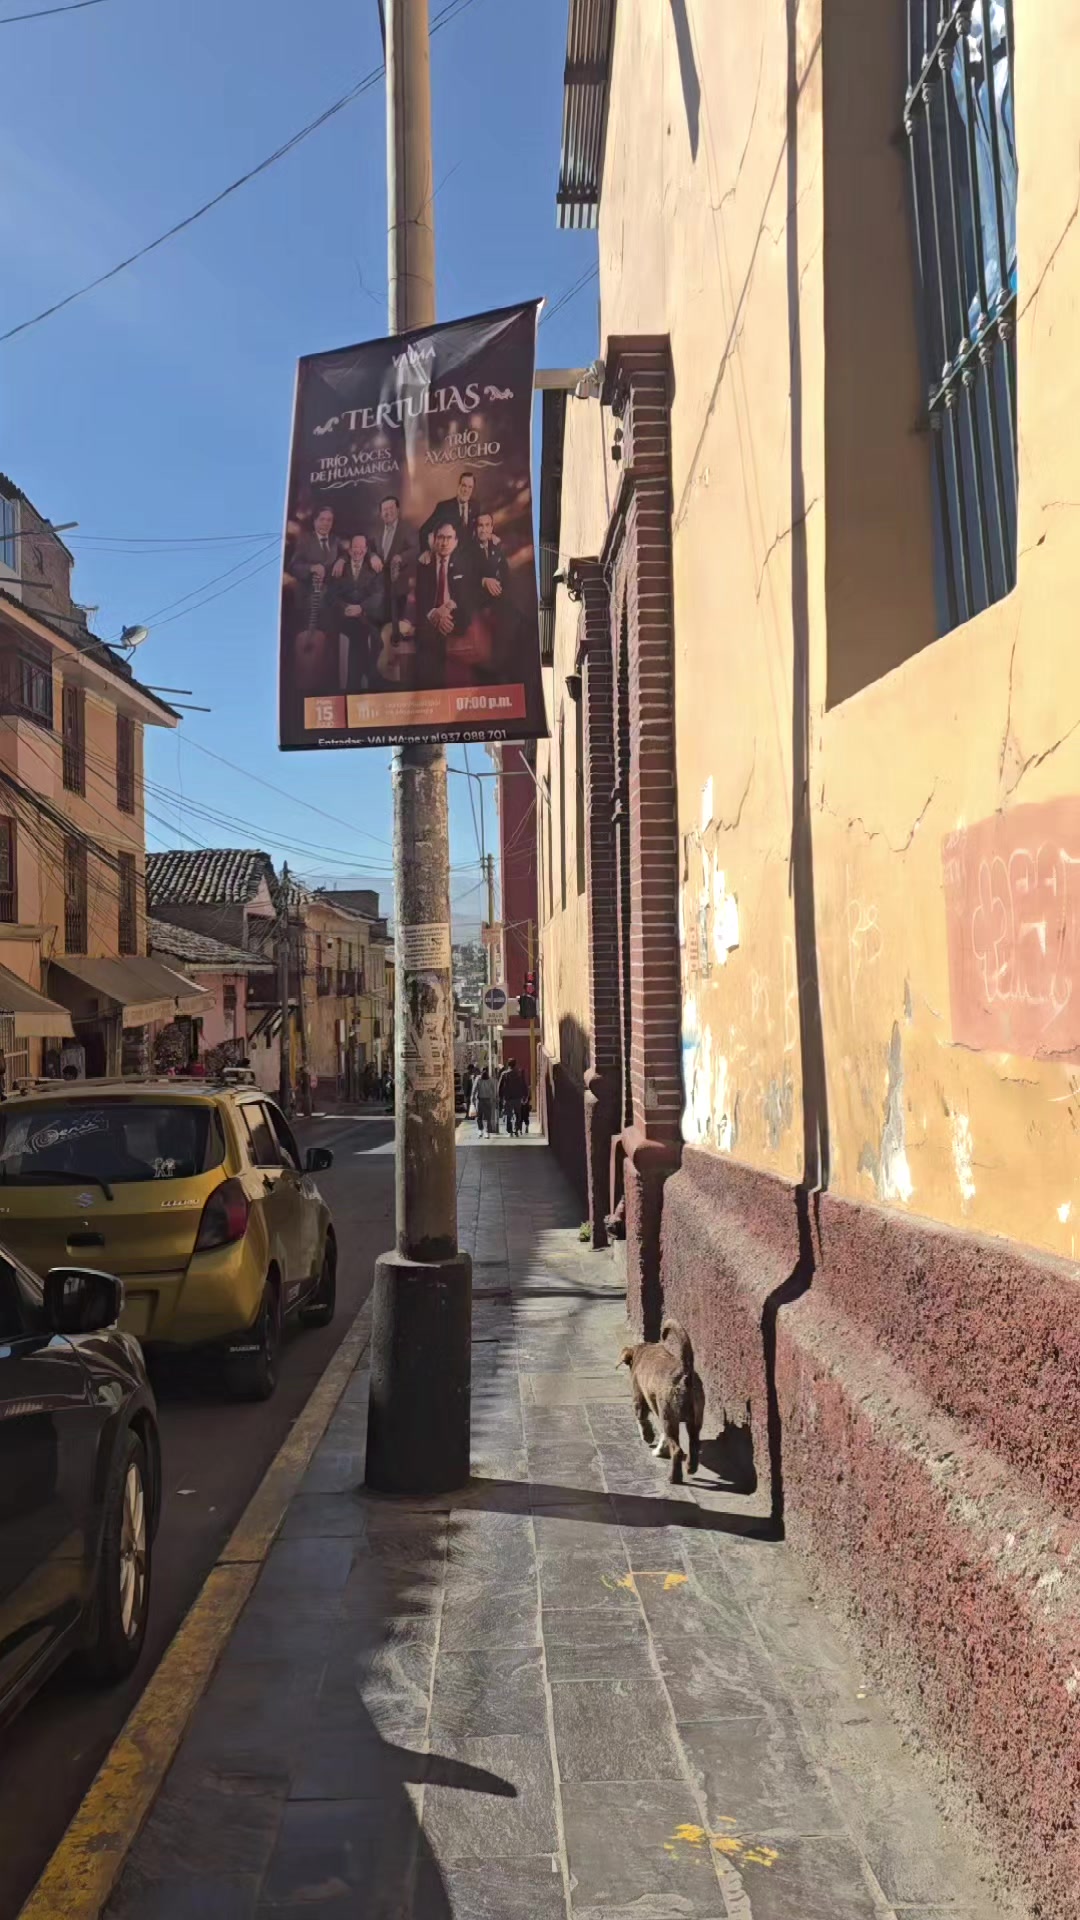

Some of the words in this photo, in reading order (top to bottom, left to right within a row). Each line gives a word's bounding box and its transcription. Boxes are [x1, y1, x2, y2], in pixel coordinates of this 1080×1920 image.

[341, 382, 480, 430] TERTULIAS
[444, 429, 479, 446] TRÍO
[319, 454, 348, 471] TRÍO
[351, 448, 392, 463] VOCES
[424, 441, 501, 465] AYACUCHO
[310, 470, 327, 483] DE
[326, 460, 400, 482] HUAMANGA
[456, 695, 486, 711] 07:00
[488, 696, 512, 709] p.m.
[315, 706, 334, 721] 15
[440, 732, 461, 742] 937
[463, 730, 485, 741] 088
[487, 729, 507, 740] 701
